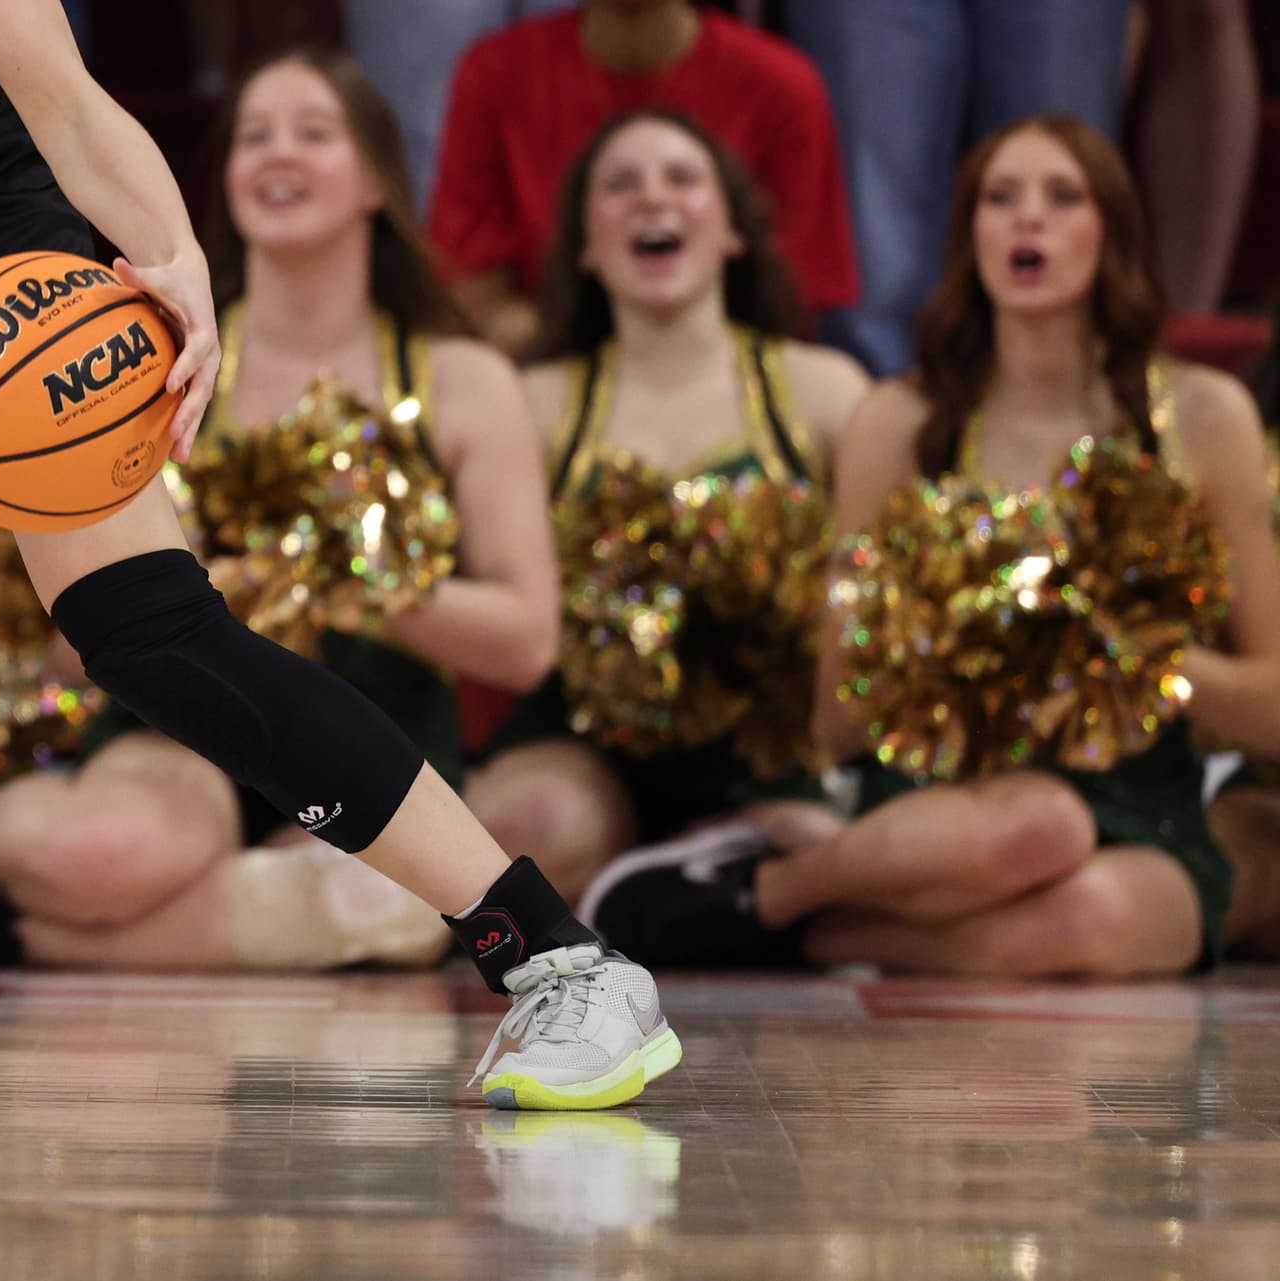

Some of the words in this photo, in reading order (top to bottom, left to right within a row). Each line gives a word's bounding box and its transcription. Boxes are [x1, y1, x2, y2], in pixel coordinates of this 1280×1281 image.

[37, 308, 60, 327] EVO
[42, 320, 158, 416] NCAA
[56, 395, 109, 428] OFFICIAL
[110, 374, 139, 396] GAME
[140, 361, 162, 377] BALL
